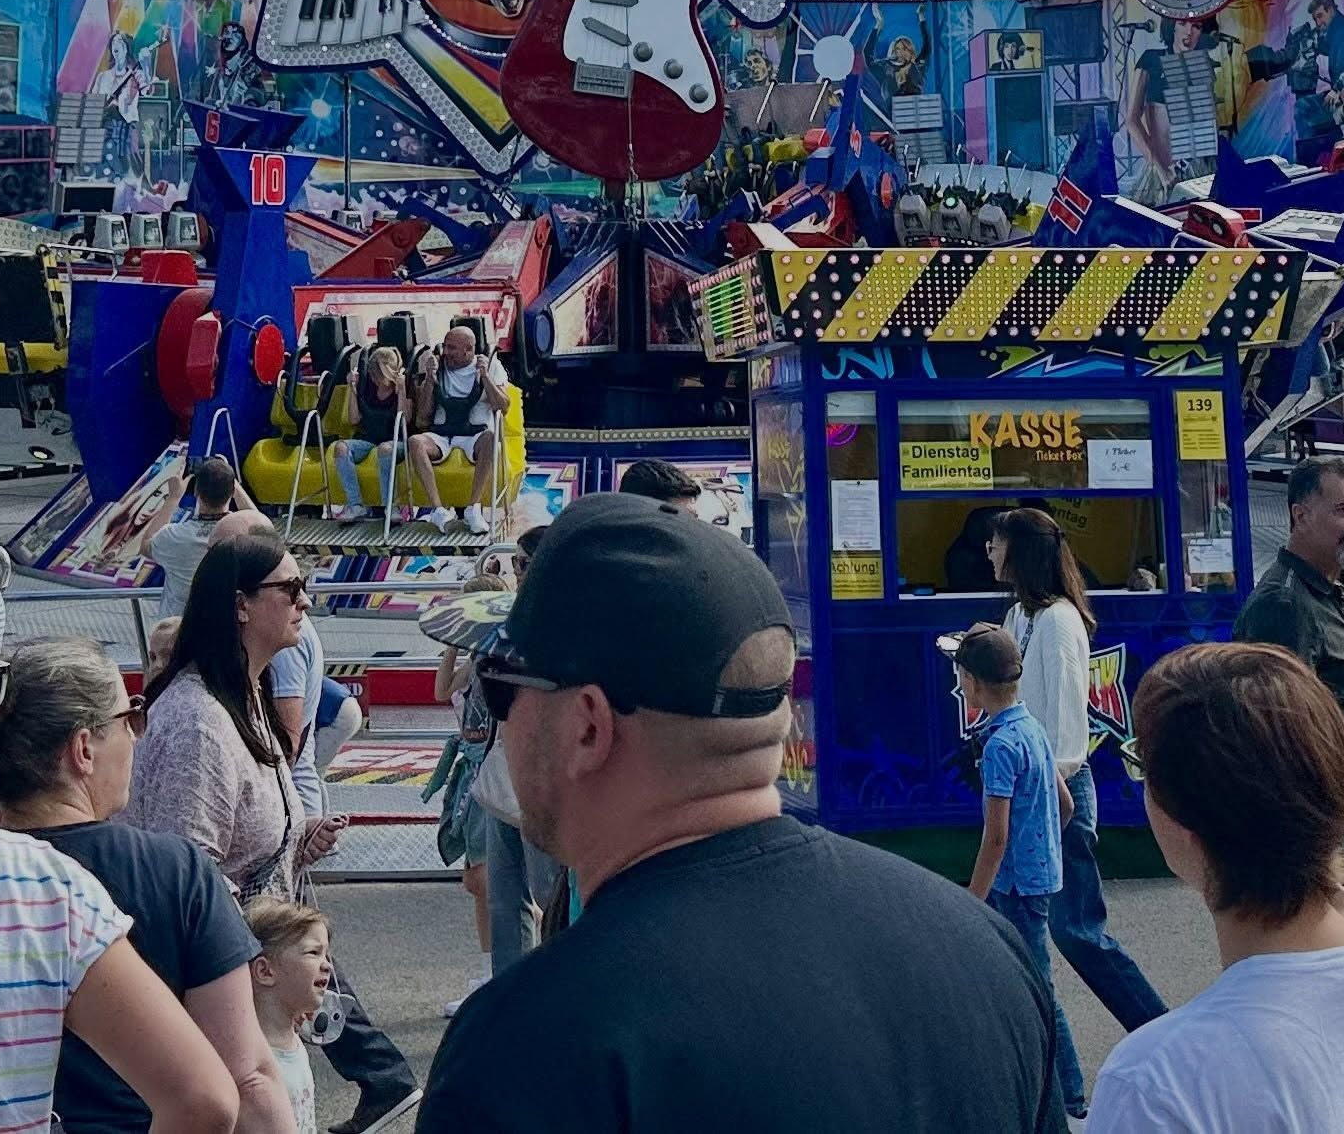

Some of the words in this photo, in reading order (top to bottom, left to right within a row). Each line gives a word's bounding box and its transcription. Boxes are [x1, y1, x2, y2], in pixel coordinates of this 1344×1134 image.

[248, 153, 287, 207] 10
[1047, 175, 1093, 235] 11
[1187, 398, 1213, 412] 139
[968, 408, 1083, 450] KASSE
[911, 444, 980, 462] Dienstag
[1035, 449, 1064, 462] Ticket
[1066, 449, 1084, 462] Box
[902, 464, 991, 481] Familientag
